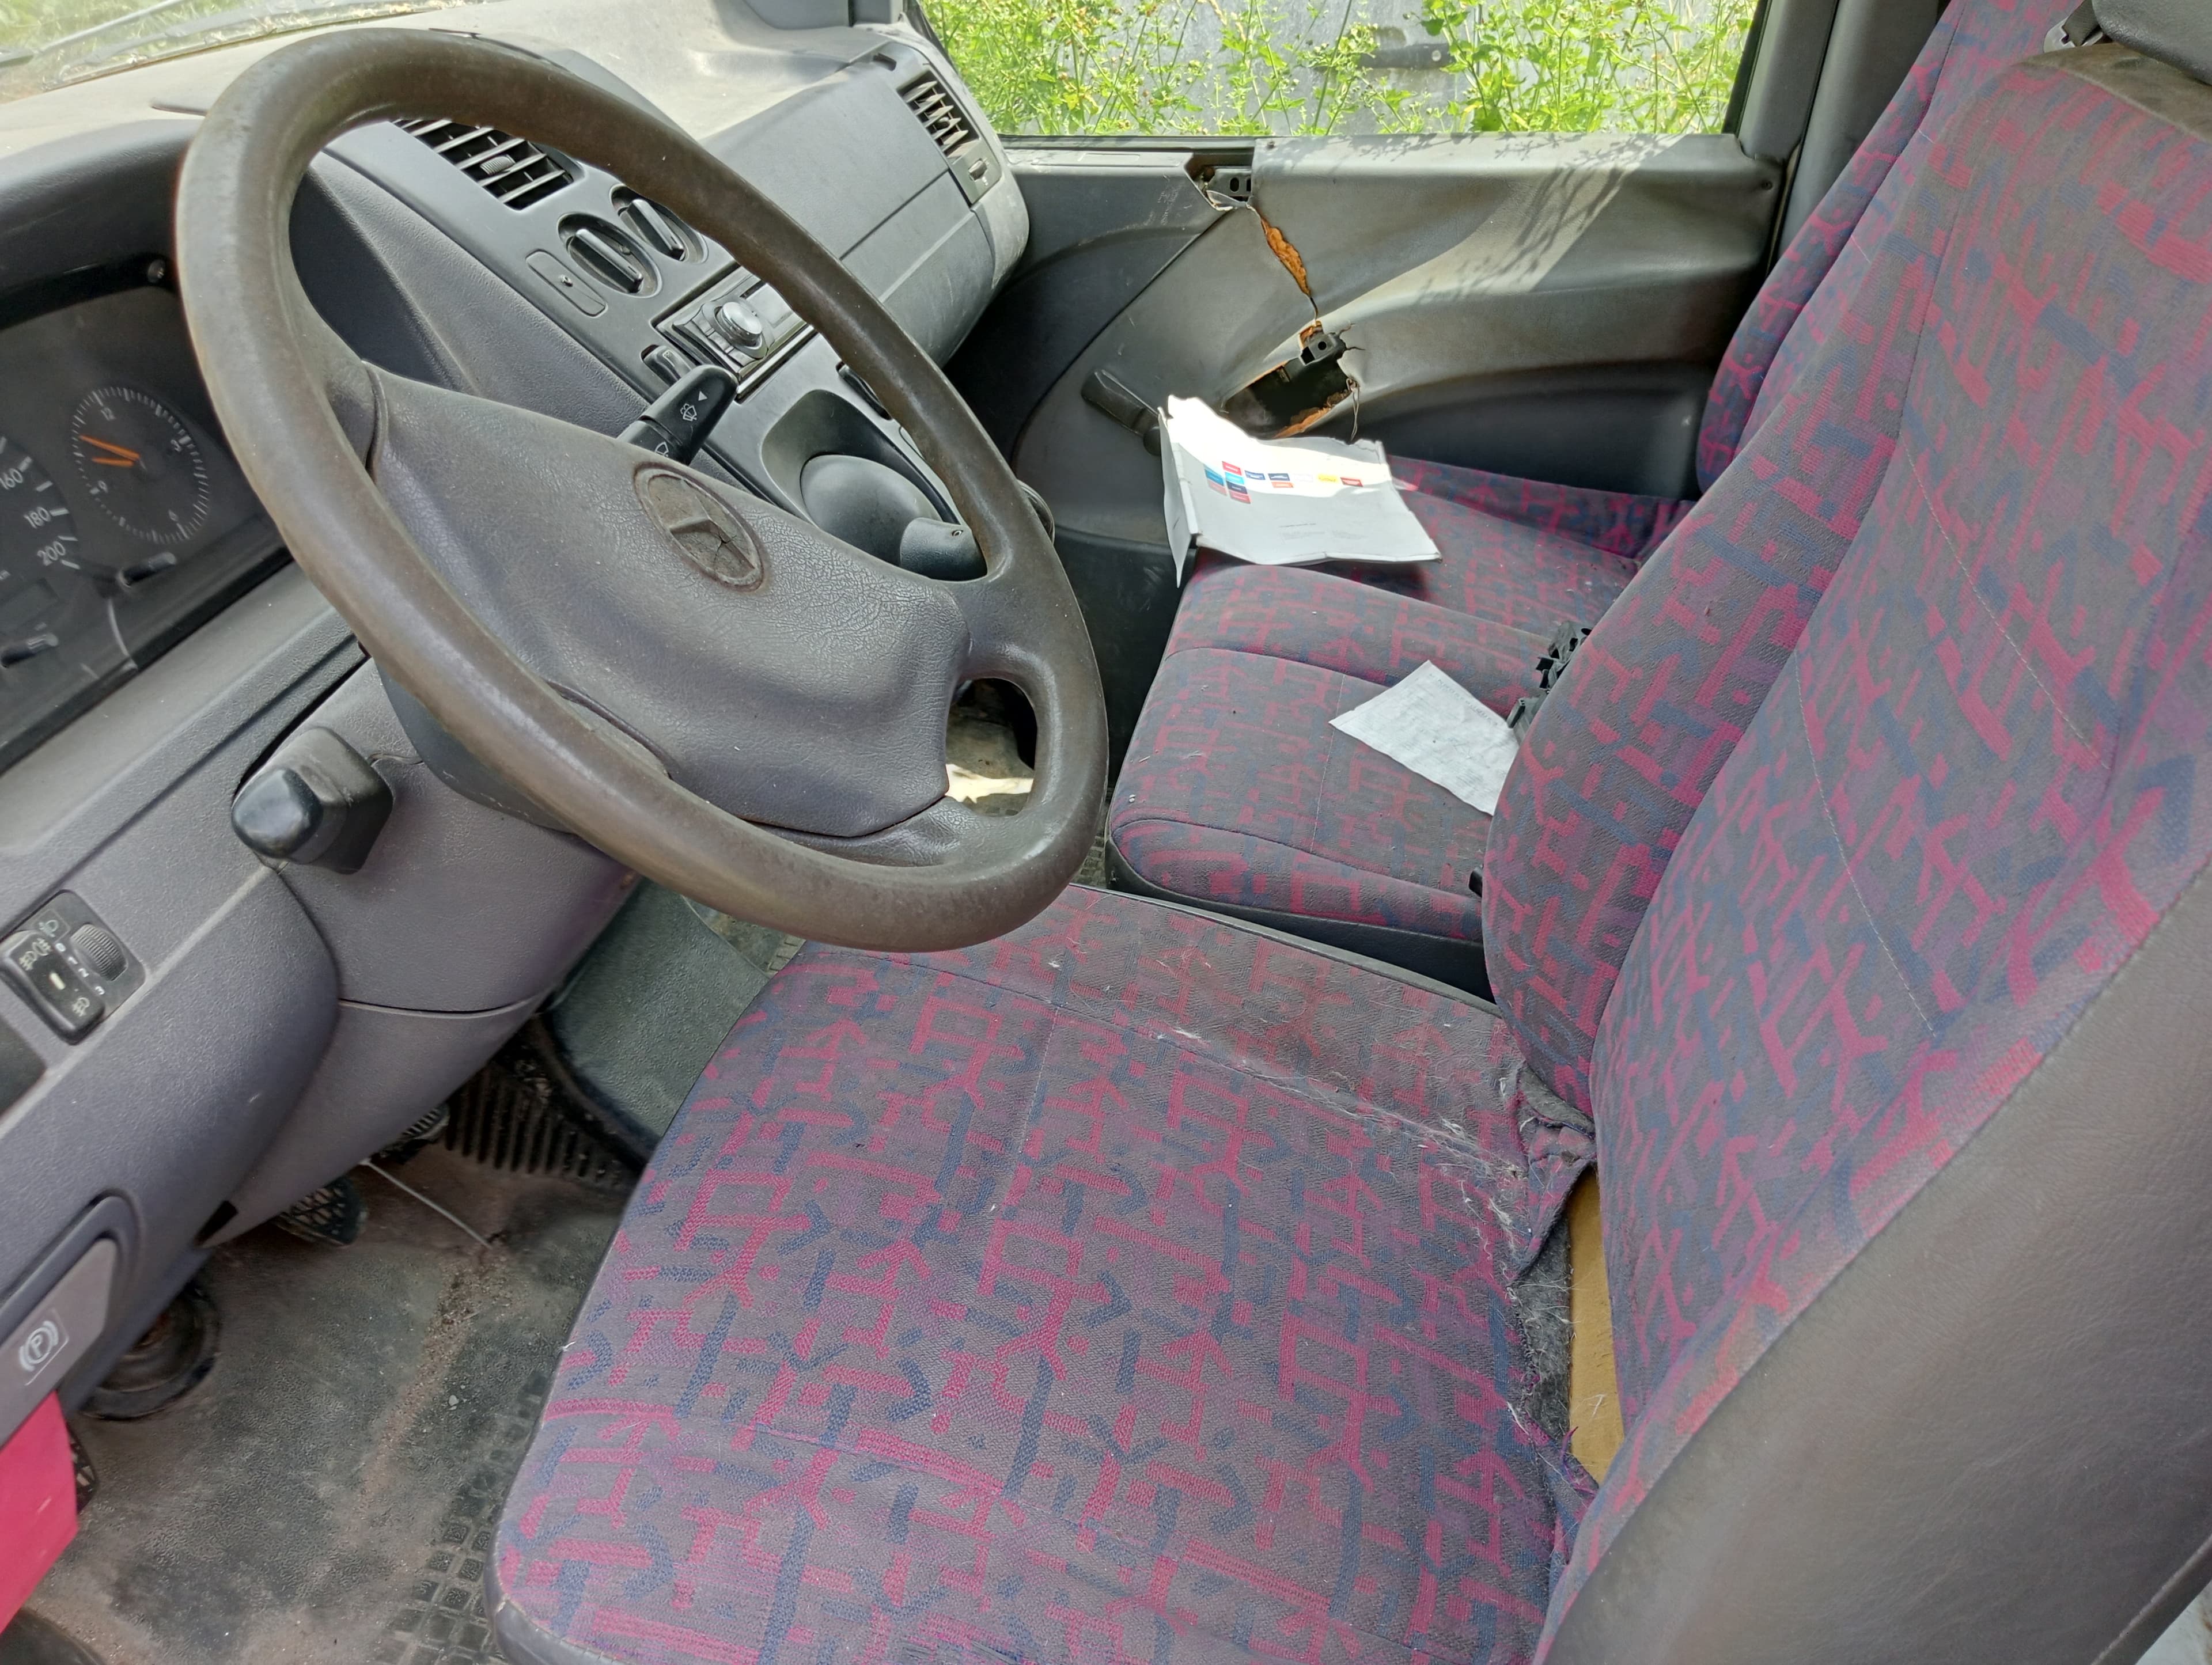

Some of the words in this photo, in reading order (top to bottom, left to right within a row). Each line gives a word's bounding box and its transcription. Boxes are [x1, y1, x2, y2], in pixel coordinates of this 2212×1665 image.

[101, 407, 115, 421] 12
[0, 468, 23, 490] 160
[98, 480, 108, 493] 9
[24, 507, 51, 529] 180
[37, 541, 66, 567] 200
[55, 943, 66, 952] 0
[78, 968, 89, 977] 2
[94, 985, 105, 995] 3
